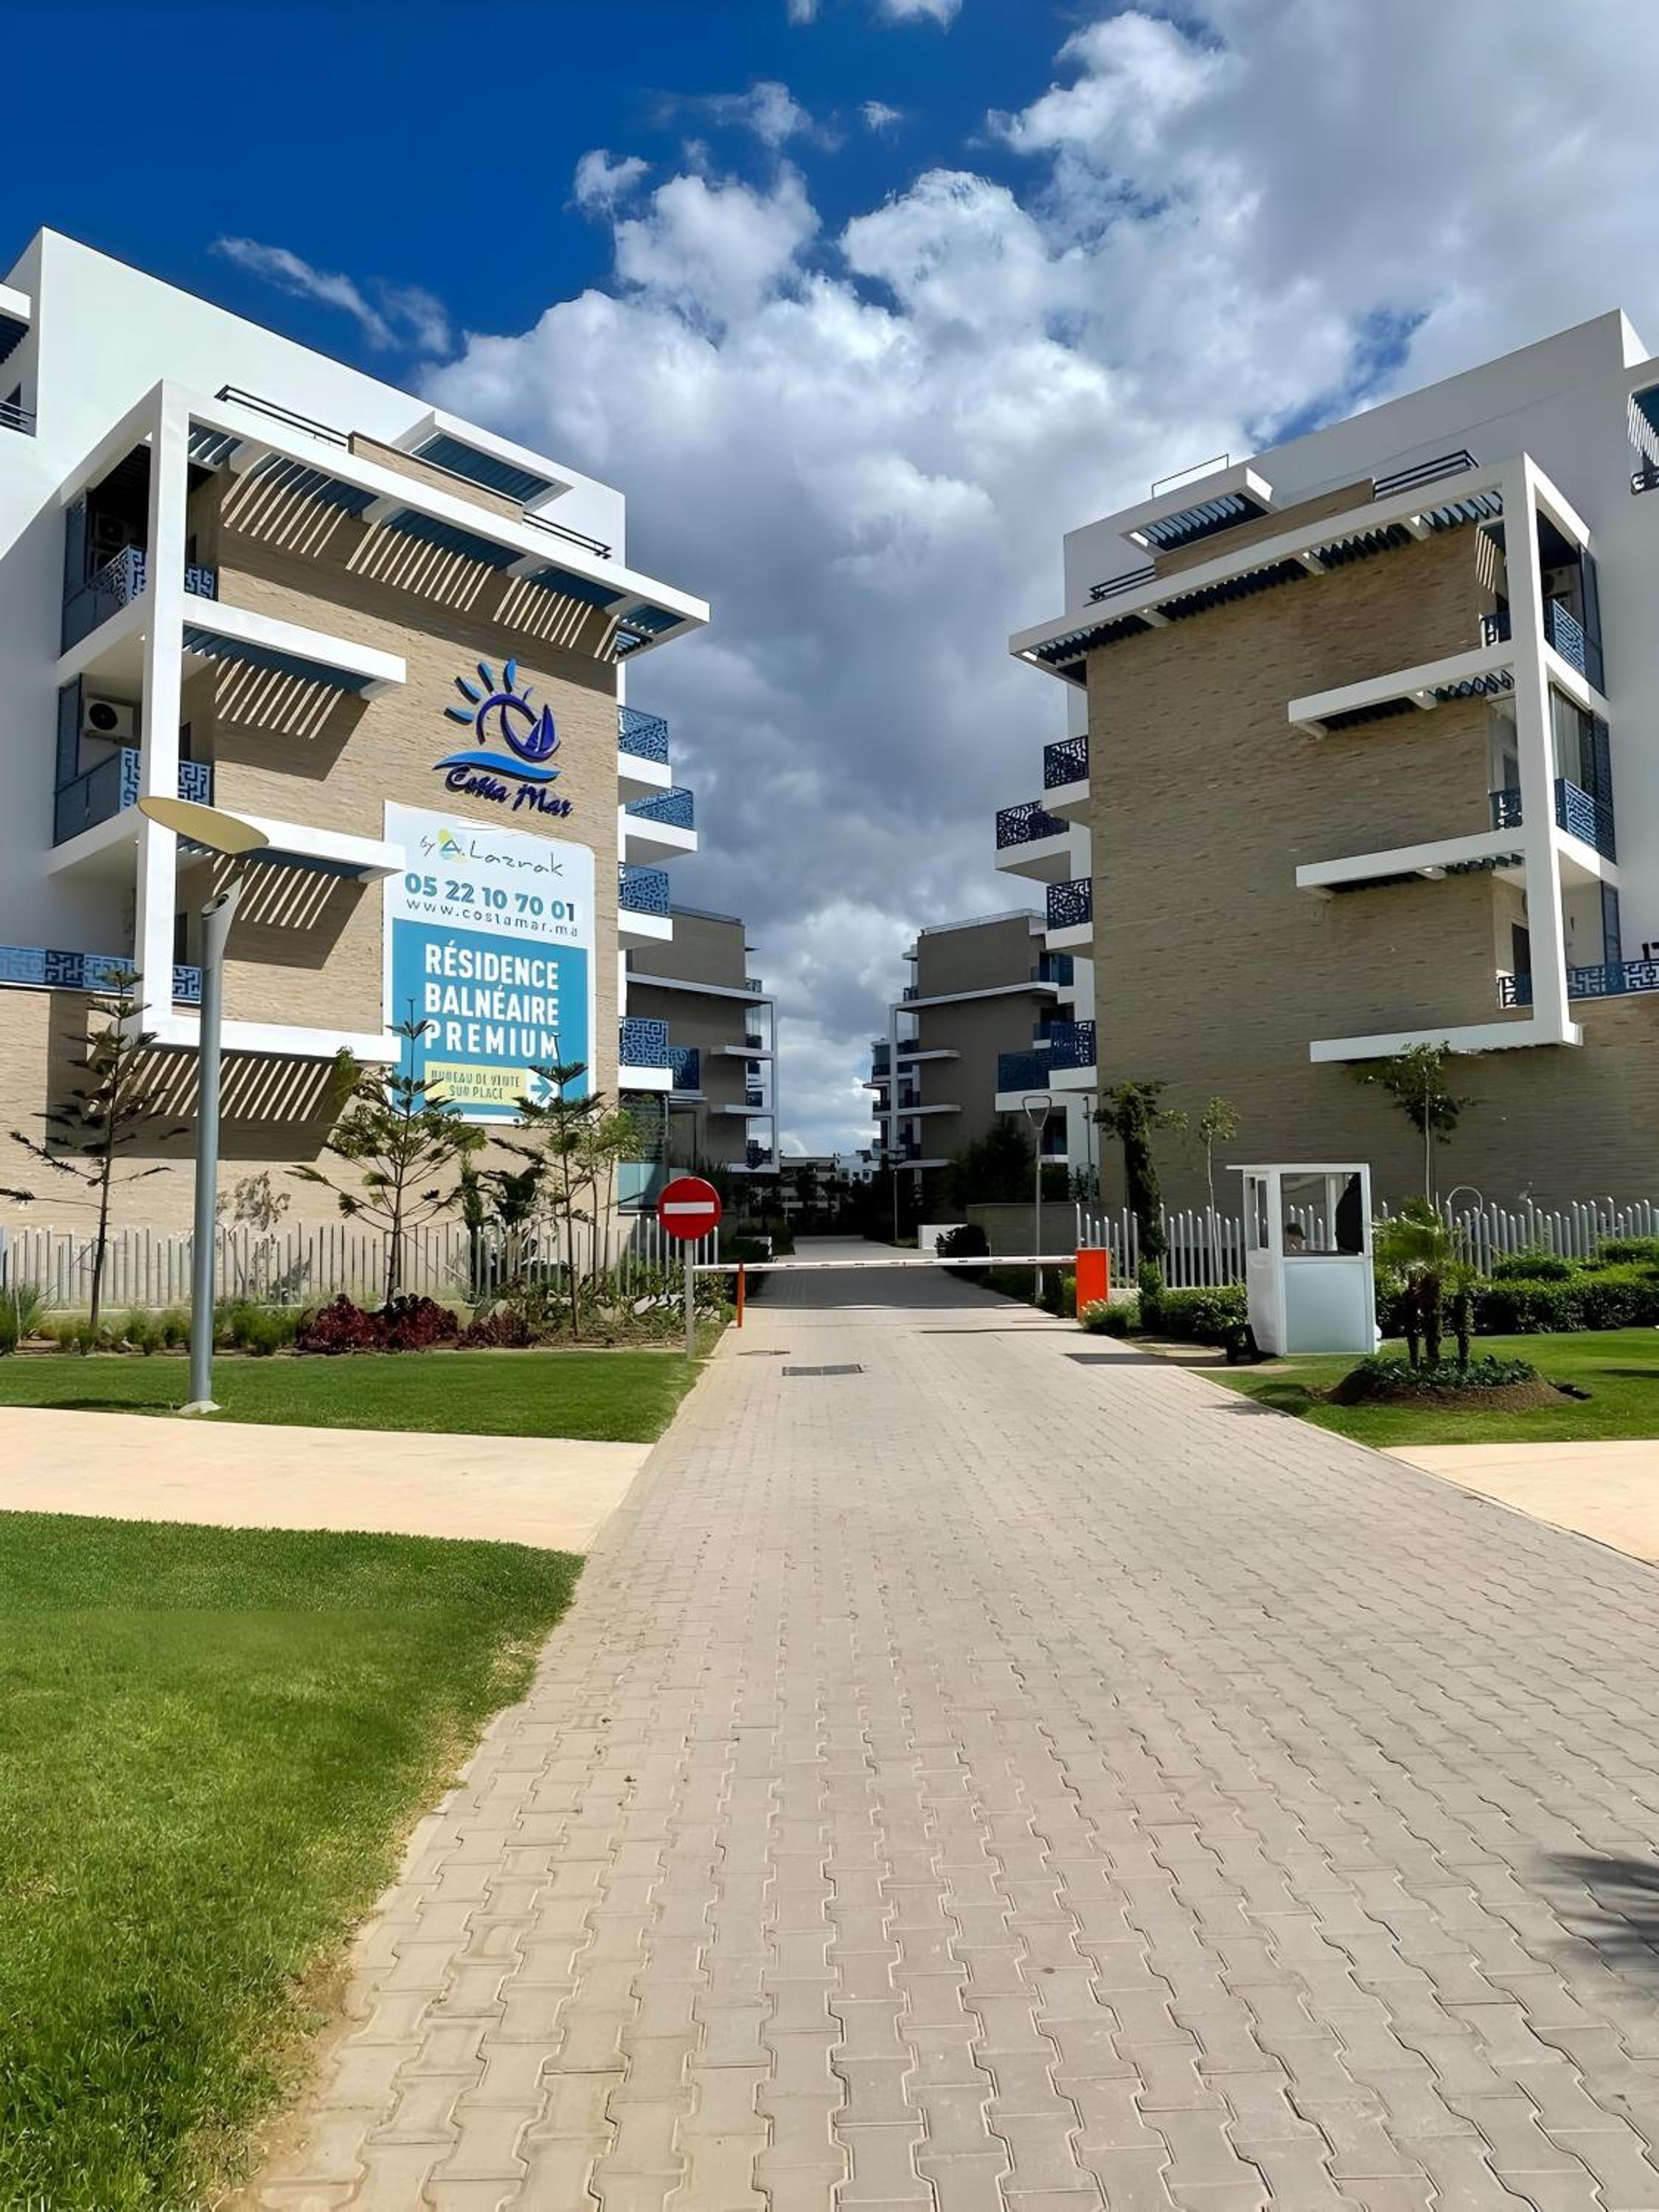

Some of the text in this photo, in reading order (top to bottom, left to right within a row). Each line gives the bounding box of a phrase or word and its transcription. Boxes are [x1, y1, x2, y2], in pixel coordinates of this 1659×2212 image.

[445, 765, 573, 818] Costa Mar
[406, 872, 574, 922] 05 22 10 70 01
[406, 898, 578, 937] www.costamar.ma
[425, 940, 559, 990] RÉSIDENCE
[425, 982, 559, 1026] BALNÉAIRE
[424, 1019, 558, 1060] PREMIUM
[449, 1085, 503, 1099] SUR PLACE
